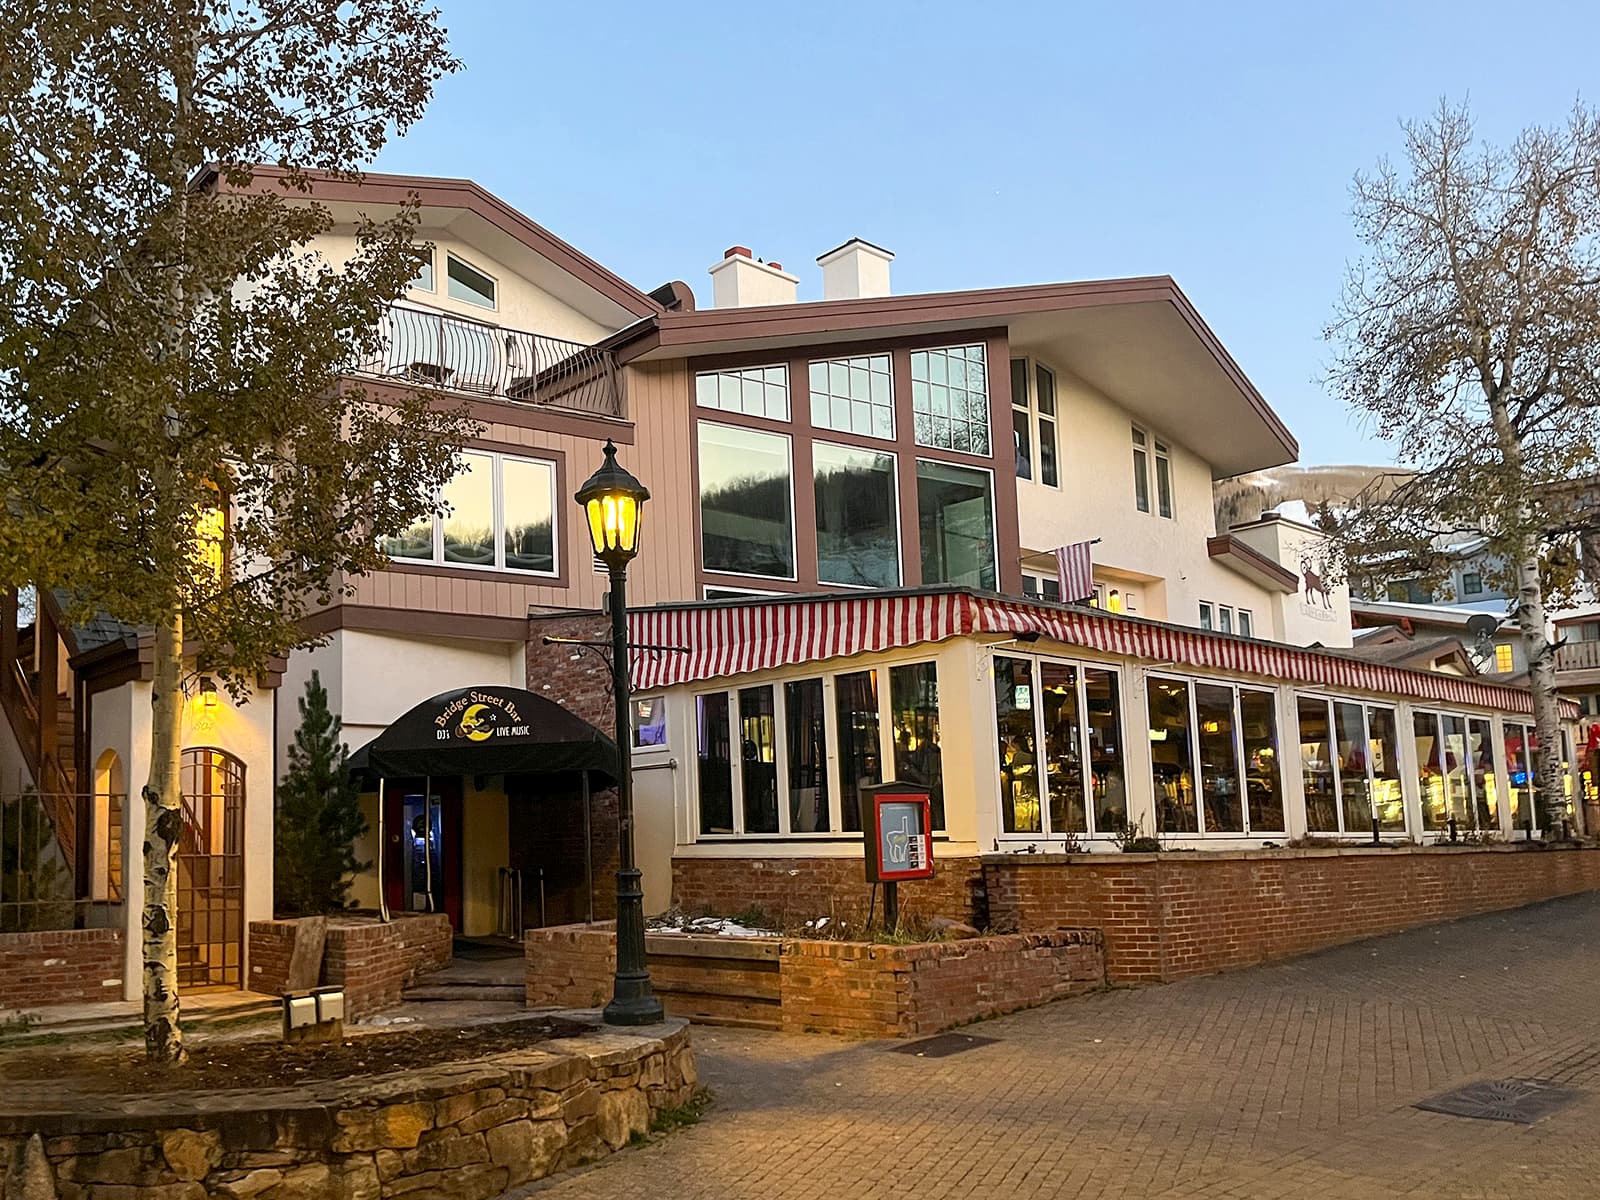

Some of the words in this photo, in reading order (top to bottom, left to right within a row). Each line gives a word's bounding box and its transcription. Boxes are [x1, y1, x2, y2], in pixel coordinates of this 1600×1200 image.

[434, 697, 468, 728] Bridge
[470, 691, 504, 707] Street
[504, 701, 522, 723] Bar
[496, 727, 510, 737] LIVE
[511, 725, 530, 736] MUSIC
